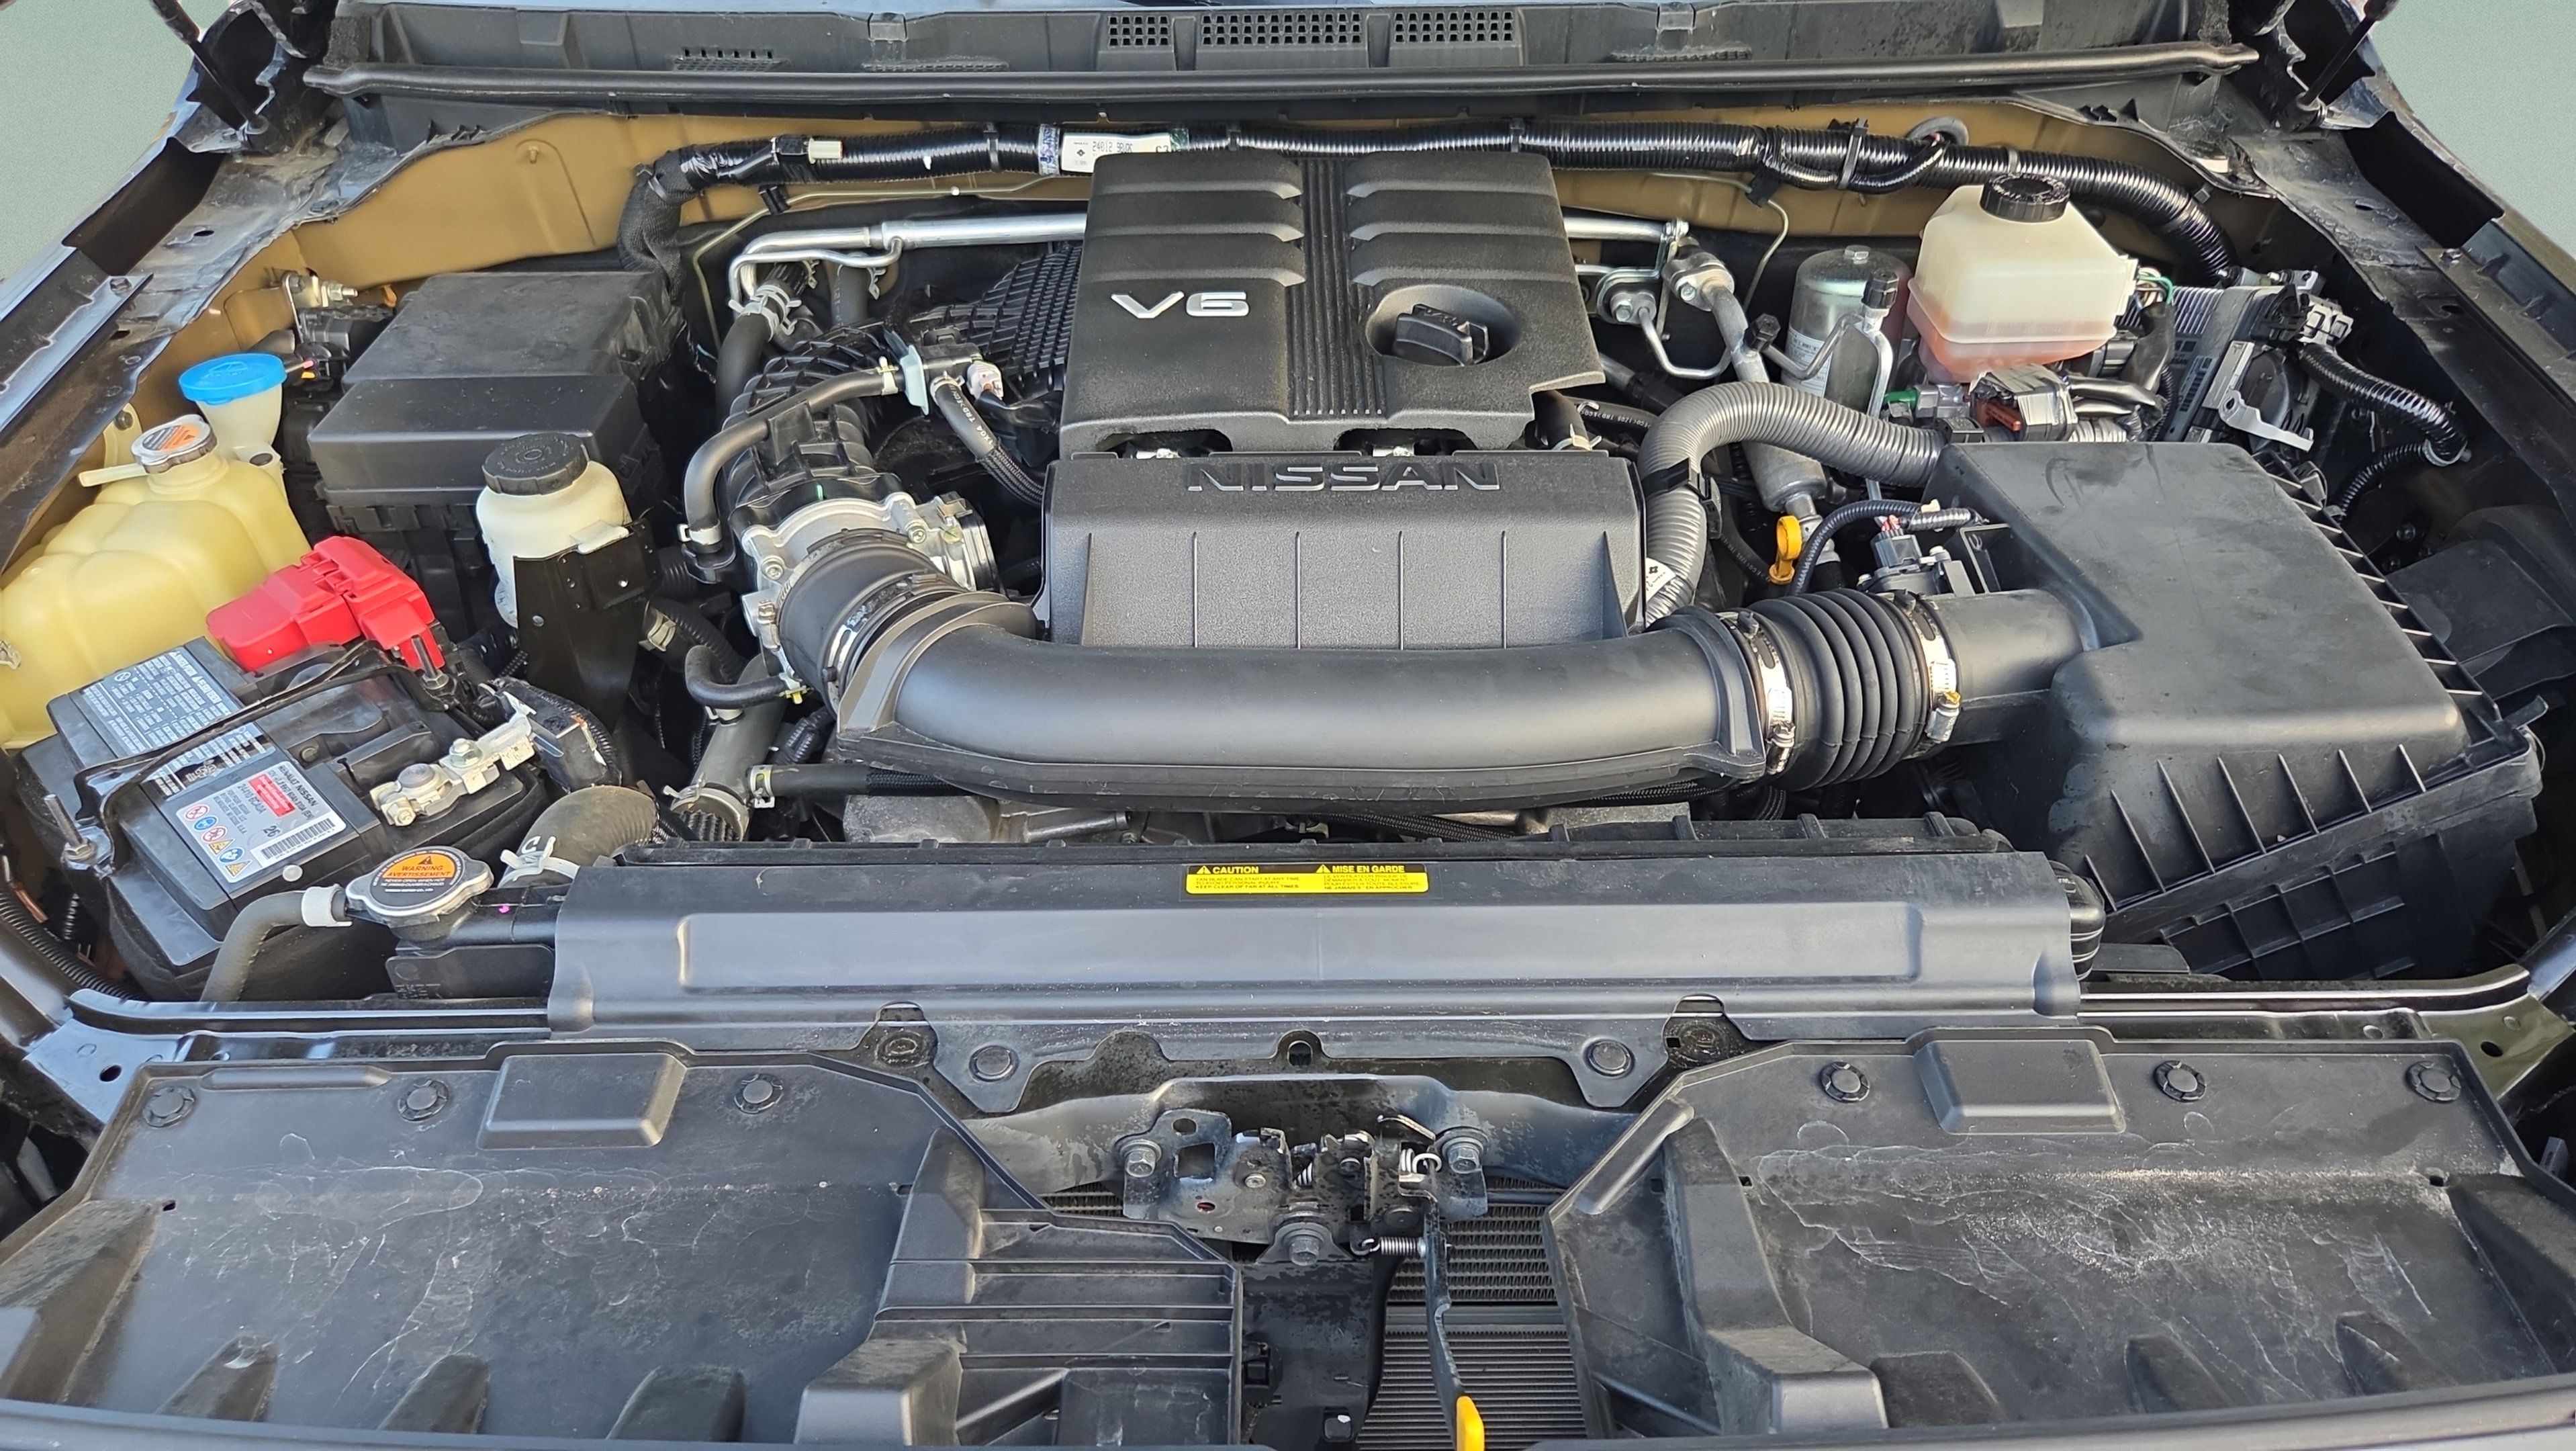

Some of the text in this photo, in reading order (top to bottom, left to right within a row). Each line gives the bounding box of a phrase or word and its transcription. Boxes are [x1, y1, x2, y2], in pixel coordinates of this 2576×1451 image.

[1111, 291, 1249, 318] V6
[1188, 462, 1500, 491] NISSAN
[295, 784, 319, 807] NISSAN
[263, 824, 281, 838] 26
[1212, 866, 1259, 874] CAUTION
[1332, 865, 1405, 873] MISE EN GARDE
